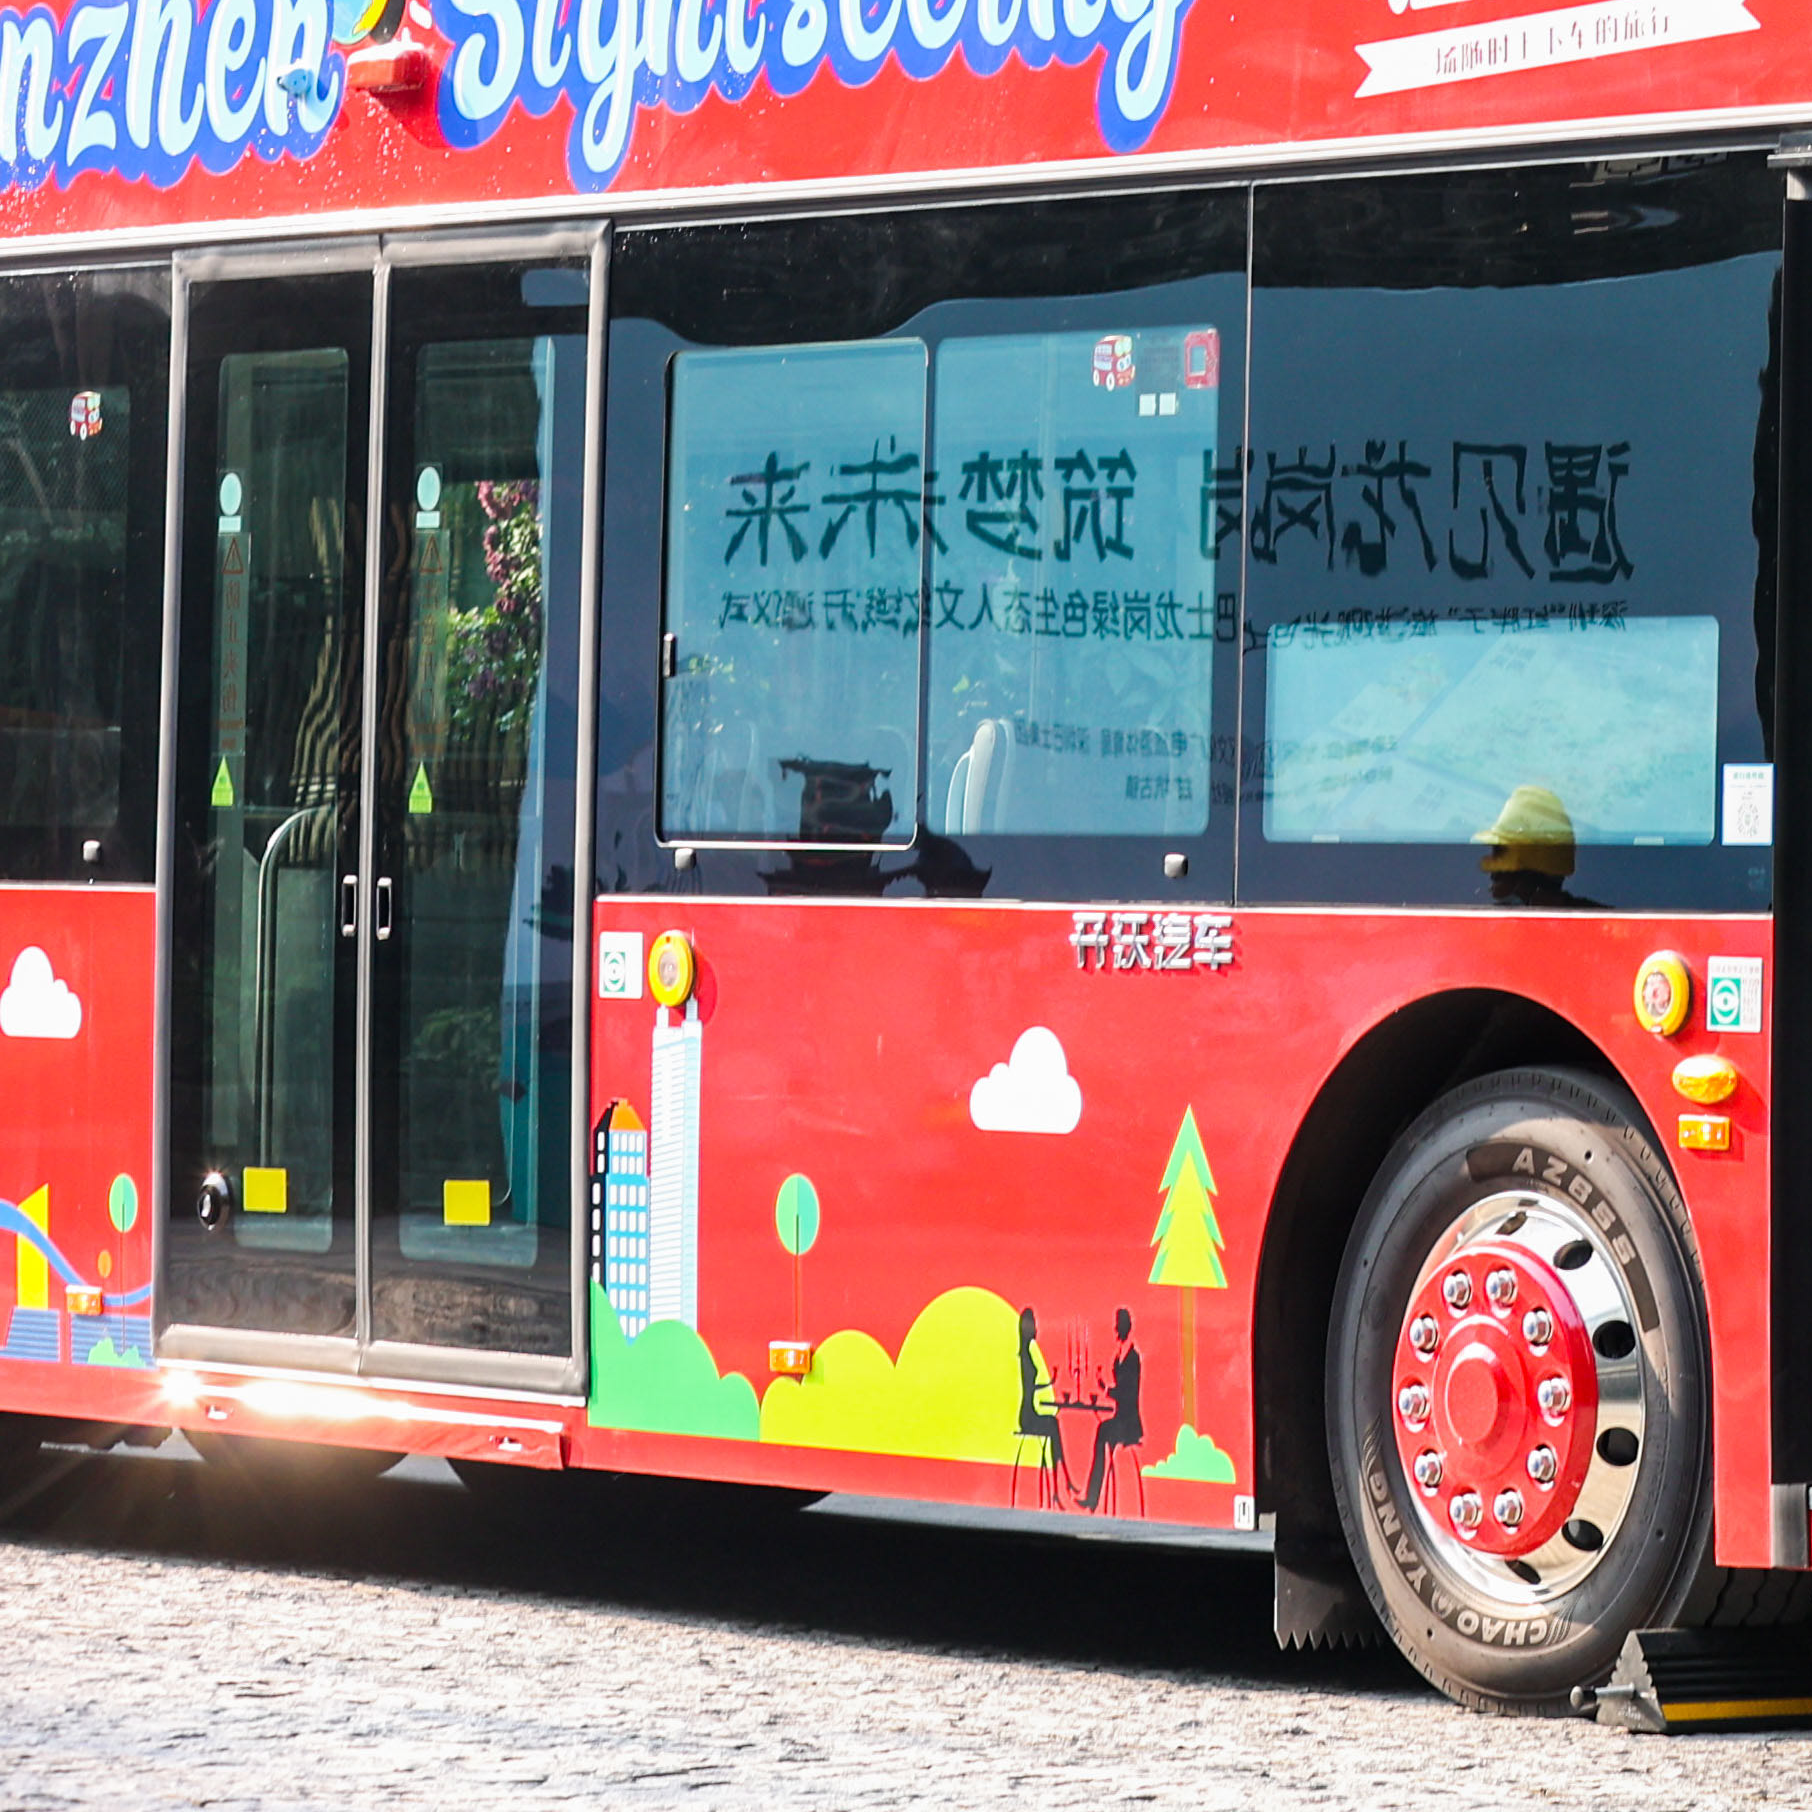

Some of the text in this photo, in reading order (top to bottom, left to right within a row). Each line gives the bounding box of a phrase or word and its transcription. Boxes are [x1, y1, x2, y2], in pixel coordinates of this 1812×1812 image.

[1069, 912, 1234, 971] 开沃汽车
[1368, 1470, 1548, 1646] CHAO YANG
